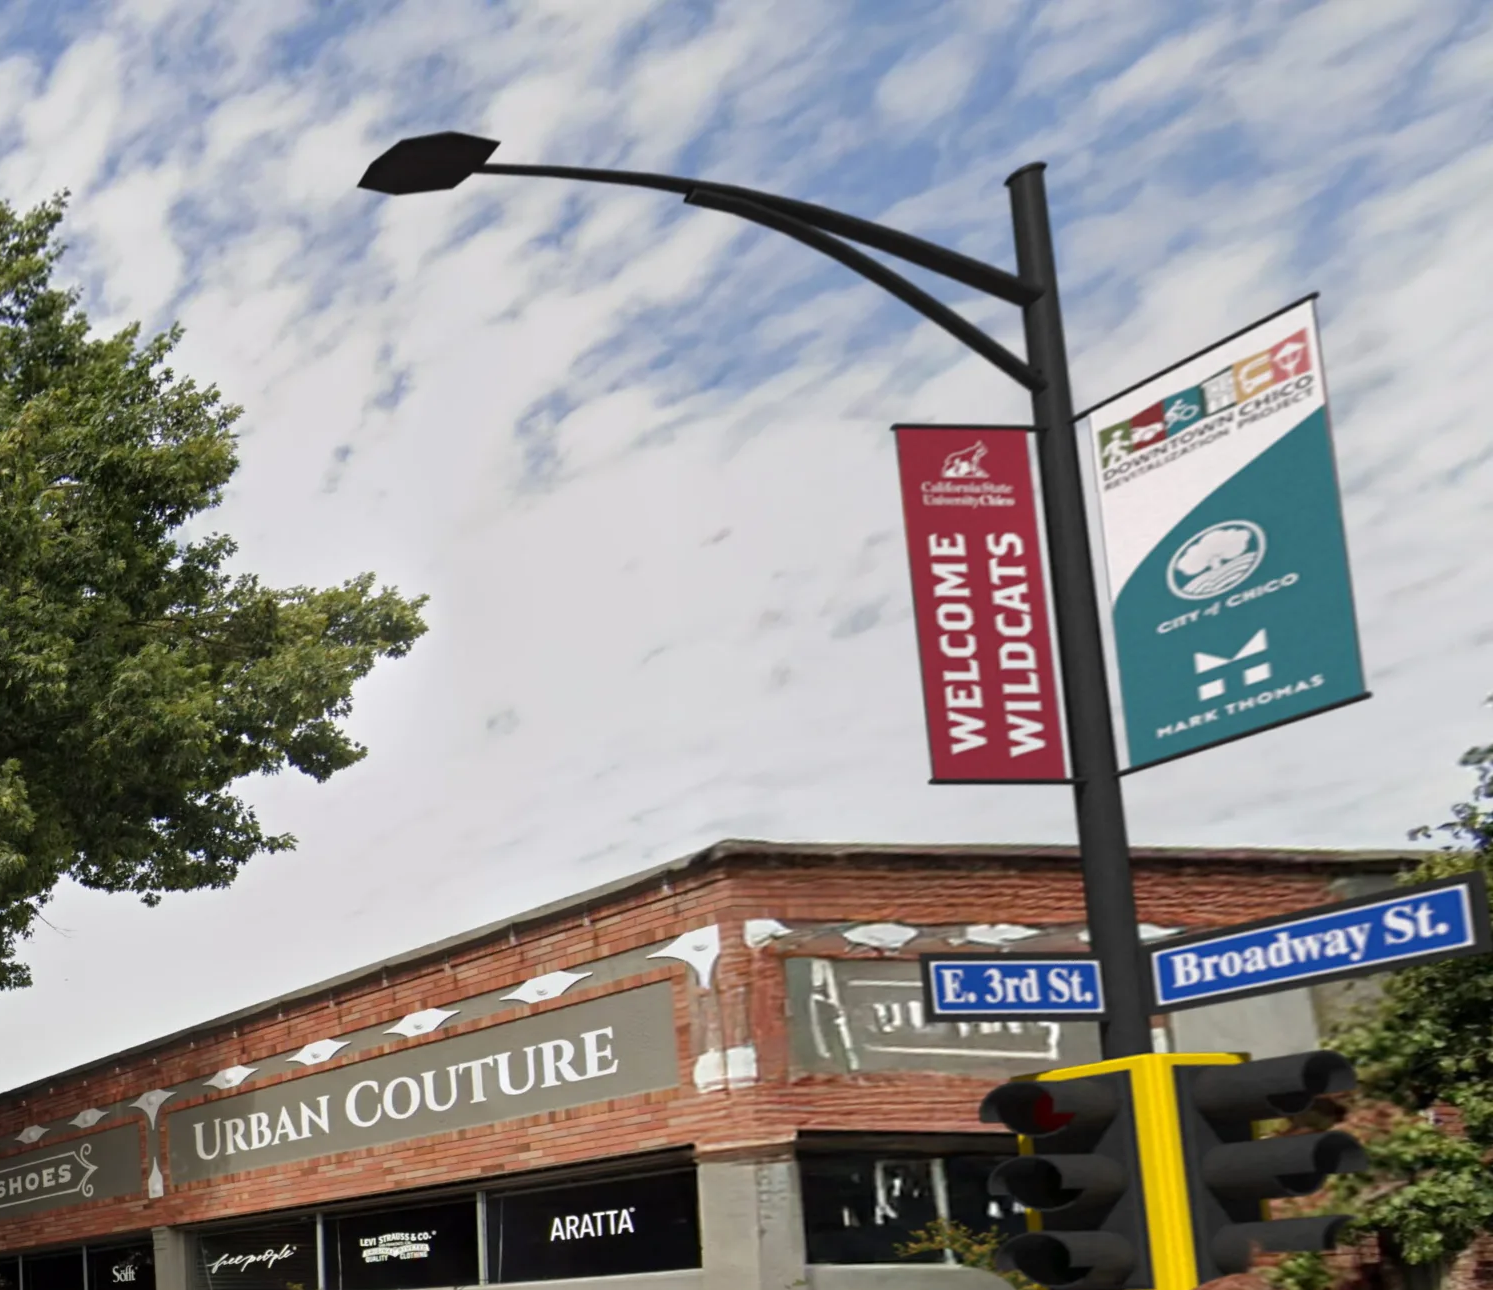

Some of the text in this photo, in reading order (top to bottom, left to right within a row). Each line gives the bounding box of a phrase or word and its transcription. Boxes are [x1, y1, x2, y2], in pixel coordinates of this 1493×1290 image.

[1103, 374, 1313, 481] DOWNTOWN CHICO
[1104, 386, 1313, 491] REVITALIZATION PROJECT
[928, 532, 988, 755] WELCOME
[985, 532, 1046, 758] WILDCATS
[1156, 609, 1200, 634] CITY
[1225, 572, 1300, 607] CHICO
[1156, 674, 1325, 739] MARK THOMAS
[942, 967, 1094, 1005] E. 3rd St.
[1169, 902, 1450, 989] Broadway St.
[194, 1026, 619, 1161] URBAN COUTURE
[359, 1237, 377, 1247] LEVI
[378, 1232, 410, 1244] STRAUSS
[410, 1232, 417, 1241] &
[550, 1208, 635, 1241] ARATTA
